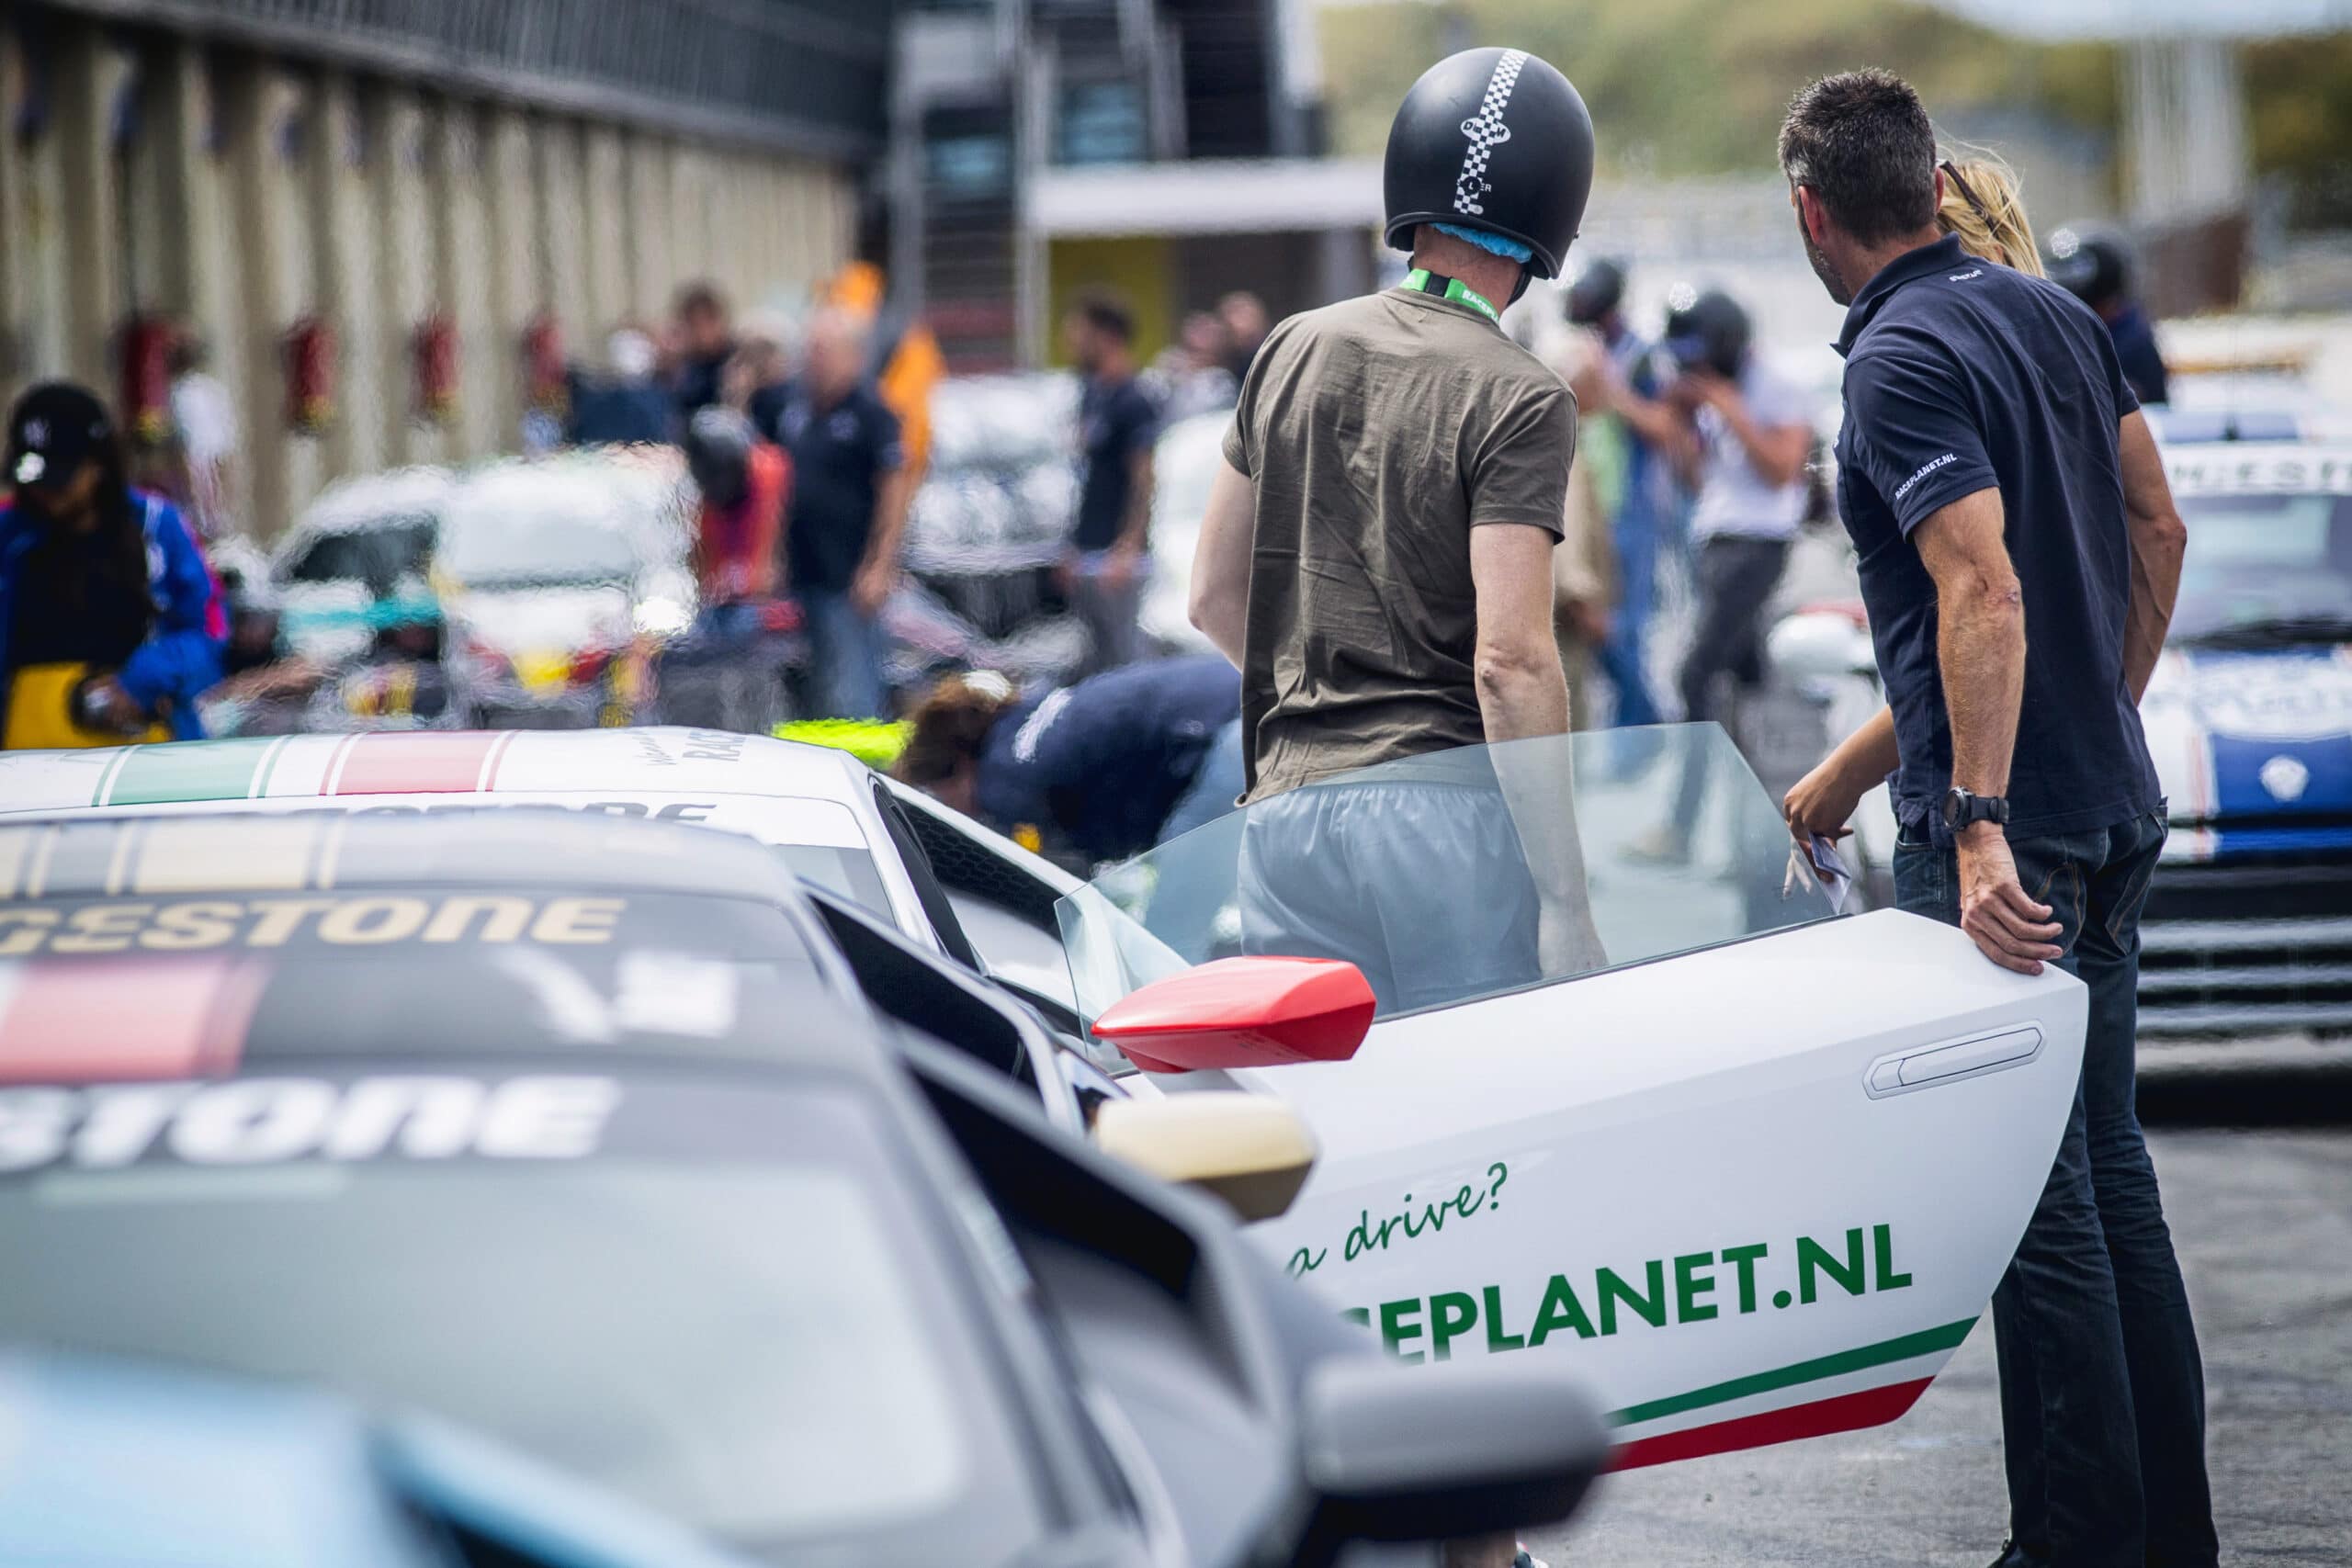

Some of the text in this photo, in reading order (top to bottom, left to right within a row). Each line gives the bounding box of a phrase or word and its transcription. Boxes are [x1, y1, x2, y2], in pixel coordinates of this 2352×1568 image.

[1894, 453, 1958, 501] RACEPLANET.NL
[1344, 1161, 1508, 1262] drive?
[1339, 1224, 1913, 1366] EPLANET.NL
